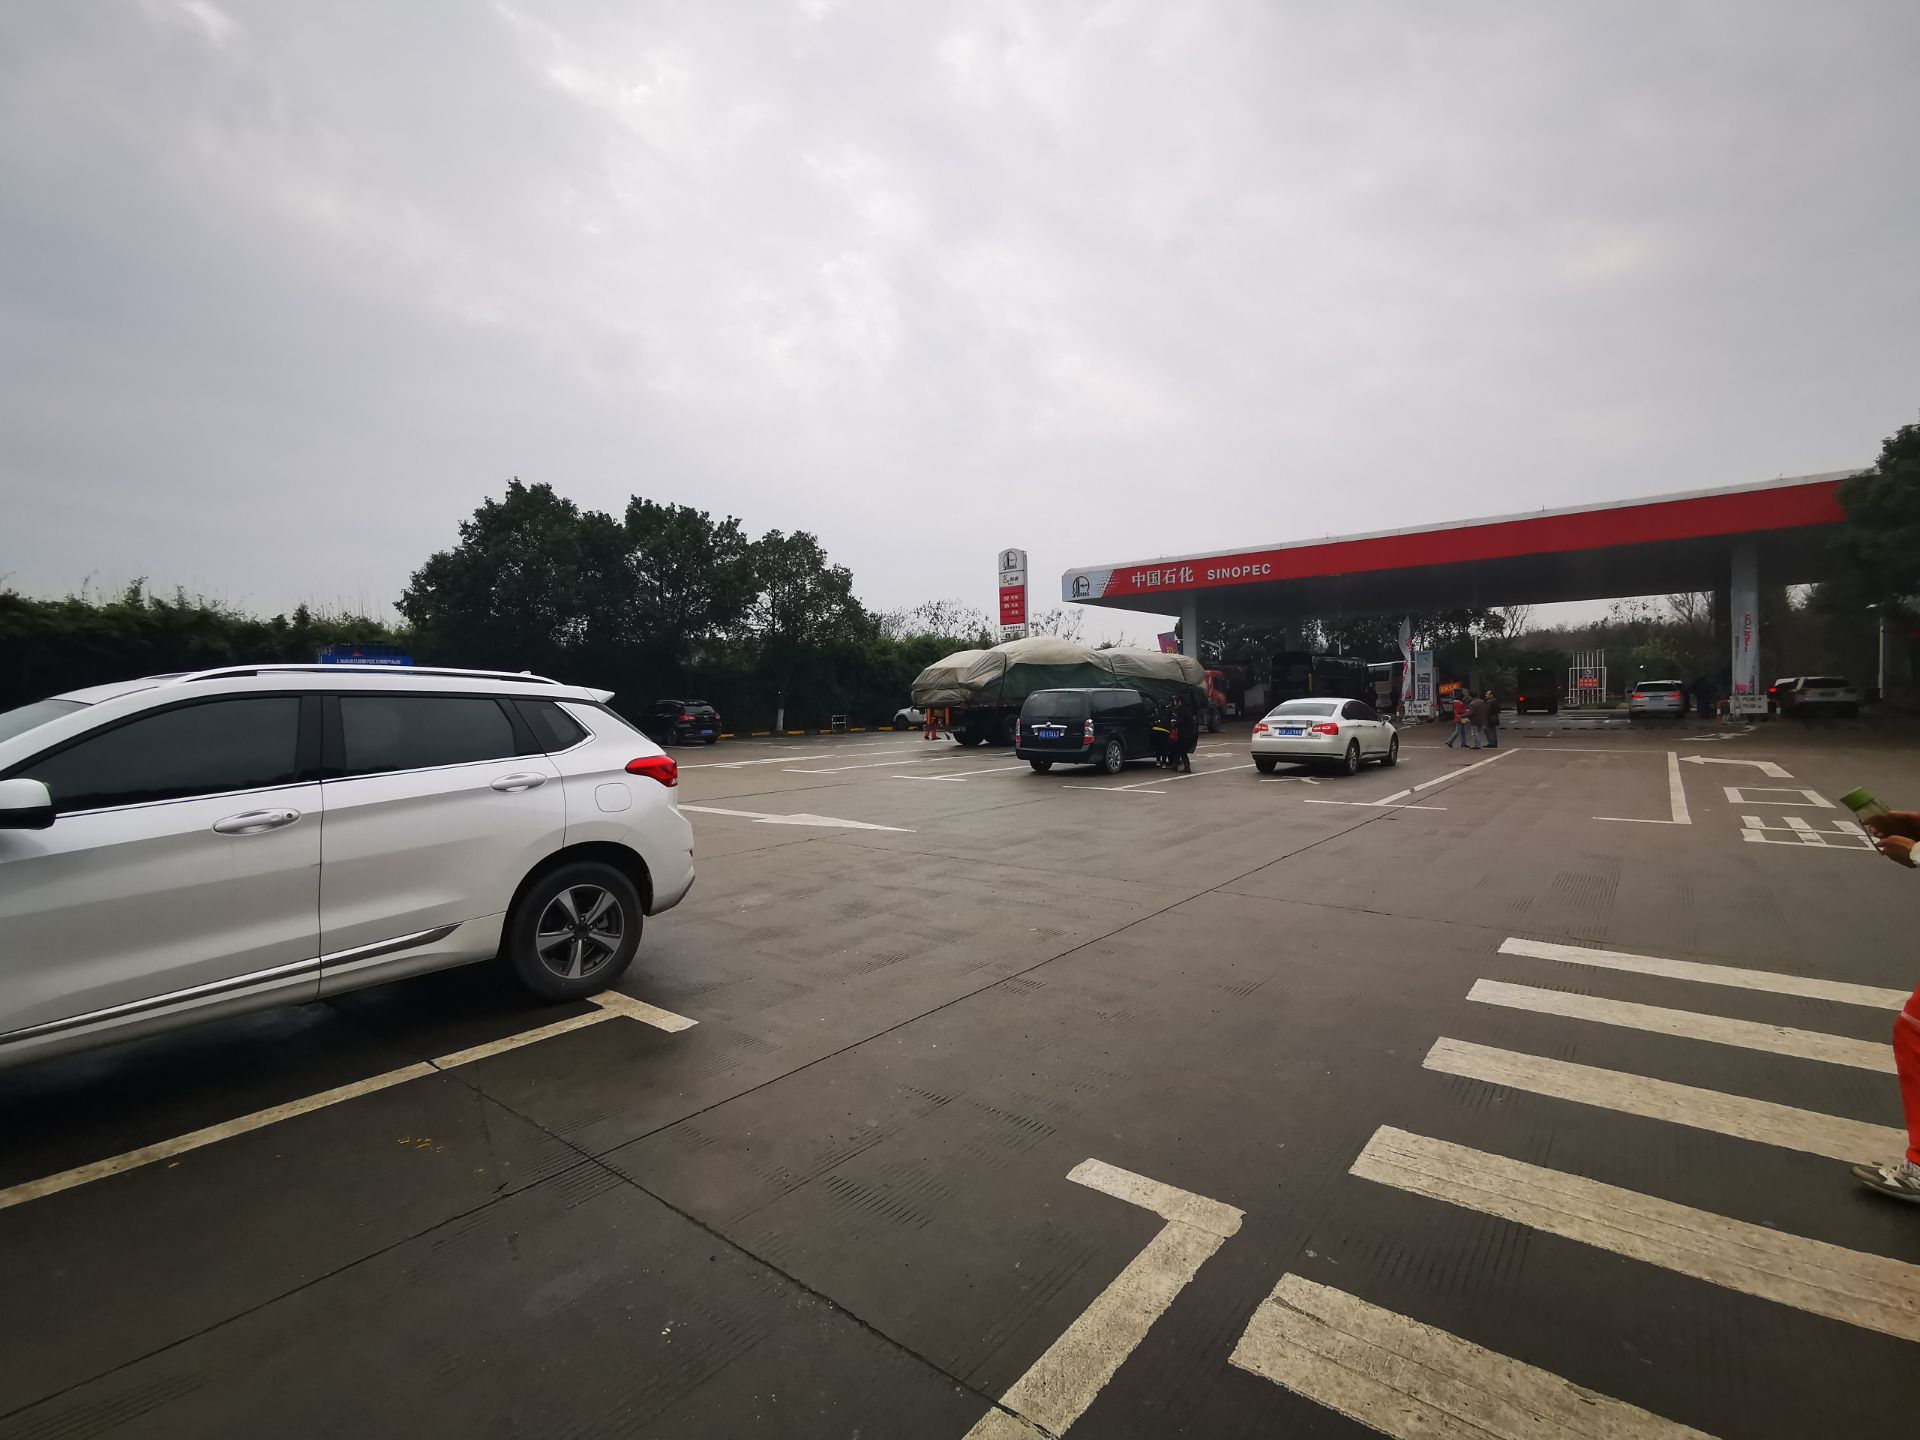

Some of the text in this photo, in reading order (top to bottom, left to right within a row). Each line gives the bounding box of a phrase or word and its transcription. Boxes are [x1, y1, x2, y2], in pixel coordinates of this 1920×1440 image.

[1131, 566, 1194, 588] 中国石化
[1207, 563, 1271, 580] SINOPEC
